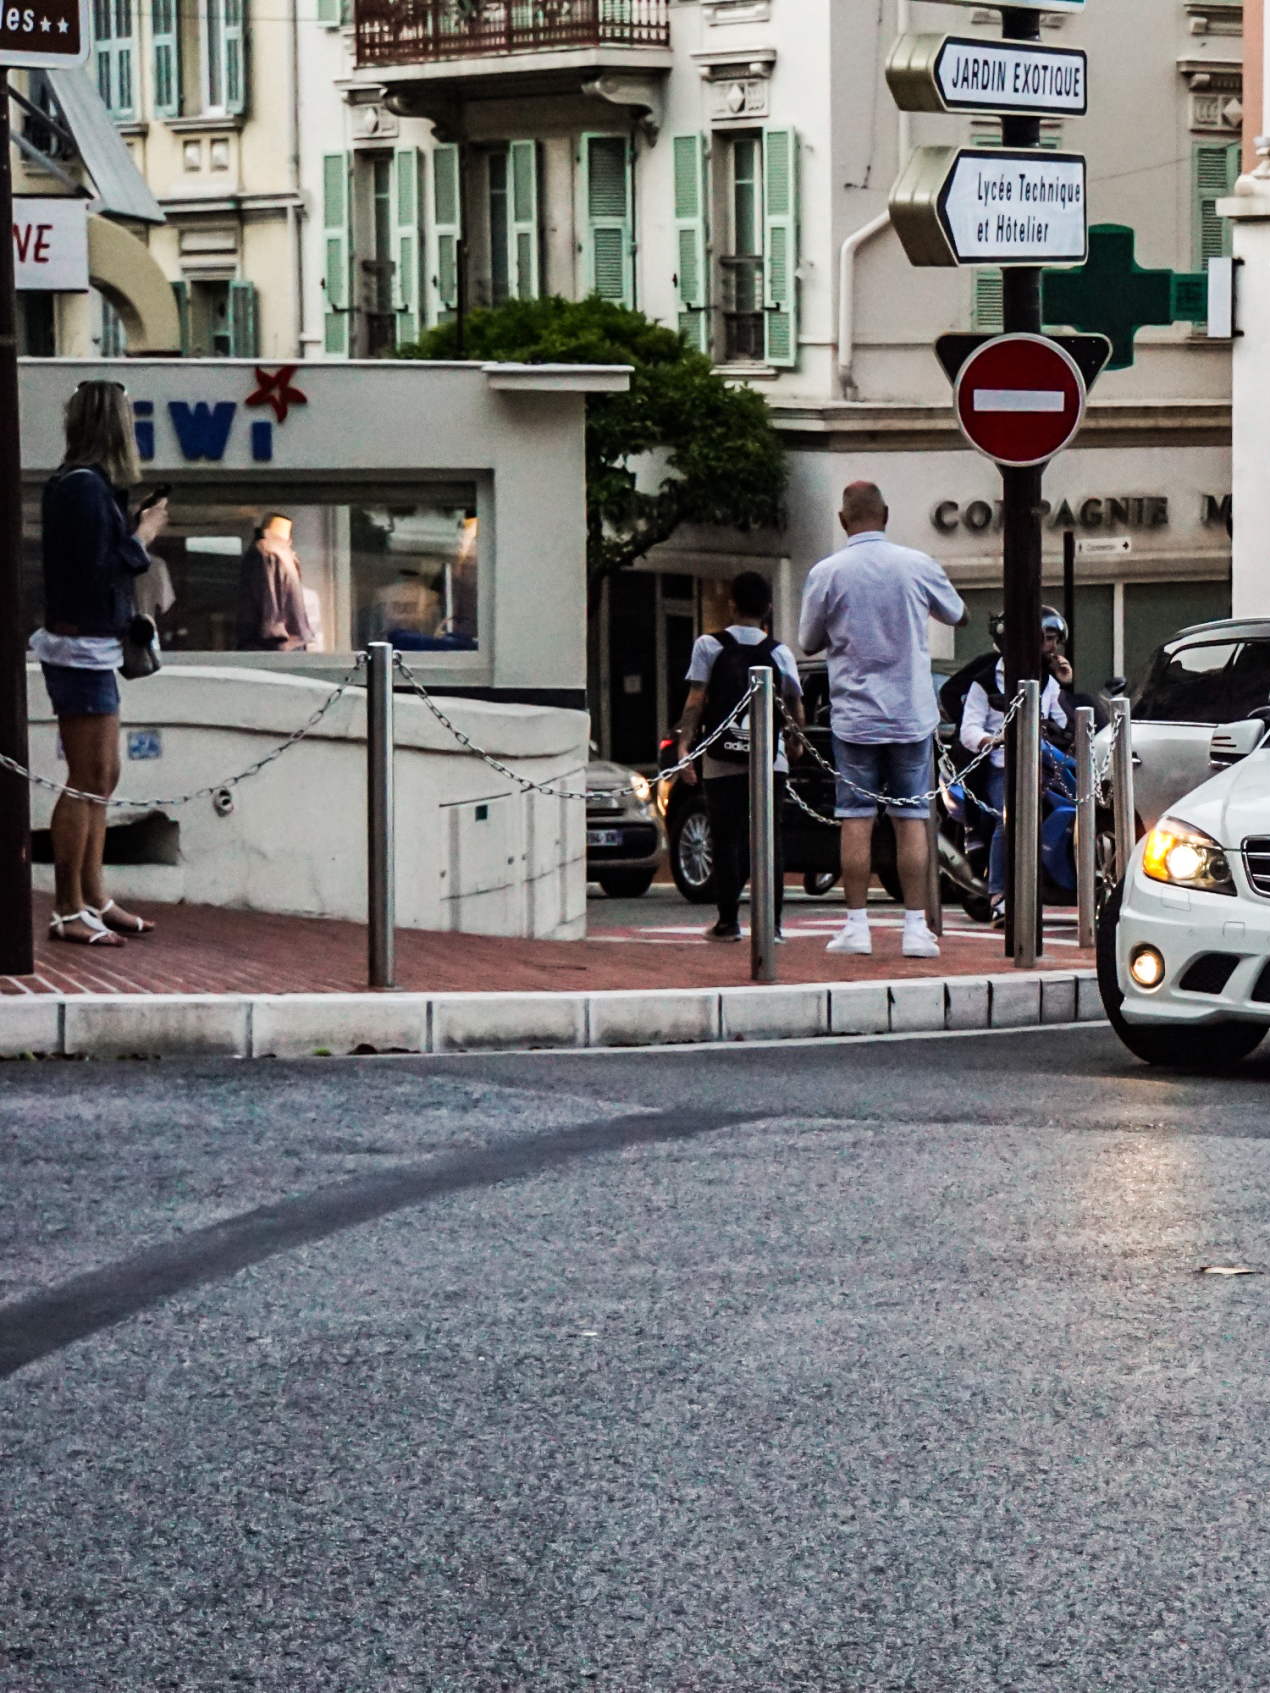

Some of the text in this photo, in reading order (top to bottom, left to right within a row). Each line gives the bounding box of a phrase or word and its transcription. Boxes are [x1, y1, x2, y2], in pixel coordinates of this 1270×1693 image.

[952, 56, 1080, 97] JARDIN EXOTIQUE
[977, 172, 1080, 210] Lycée Technique
[977, 214, 1048, 243] et Hôtelier
